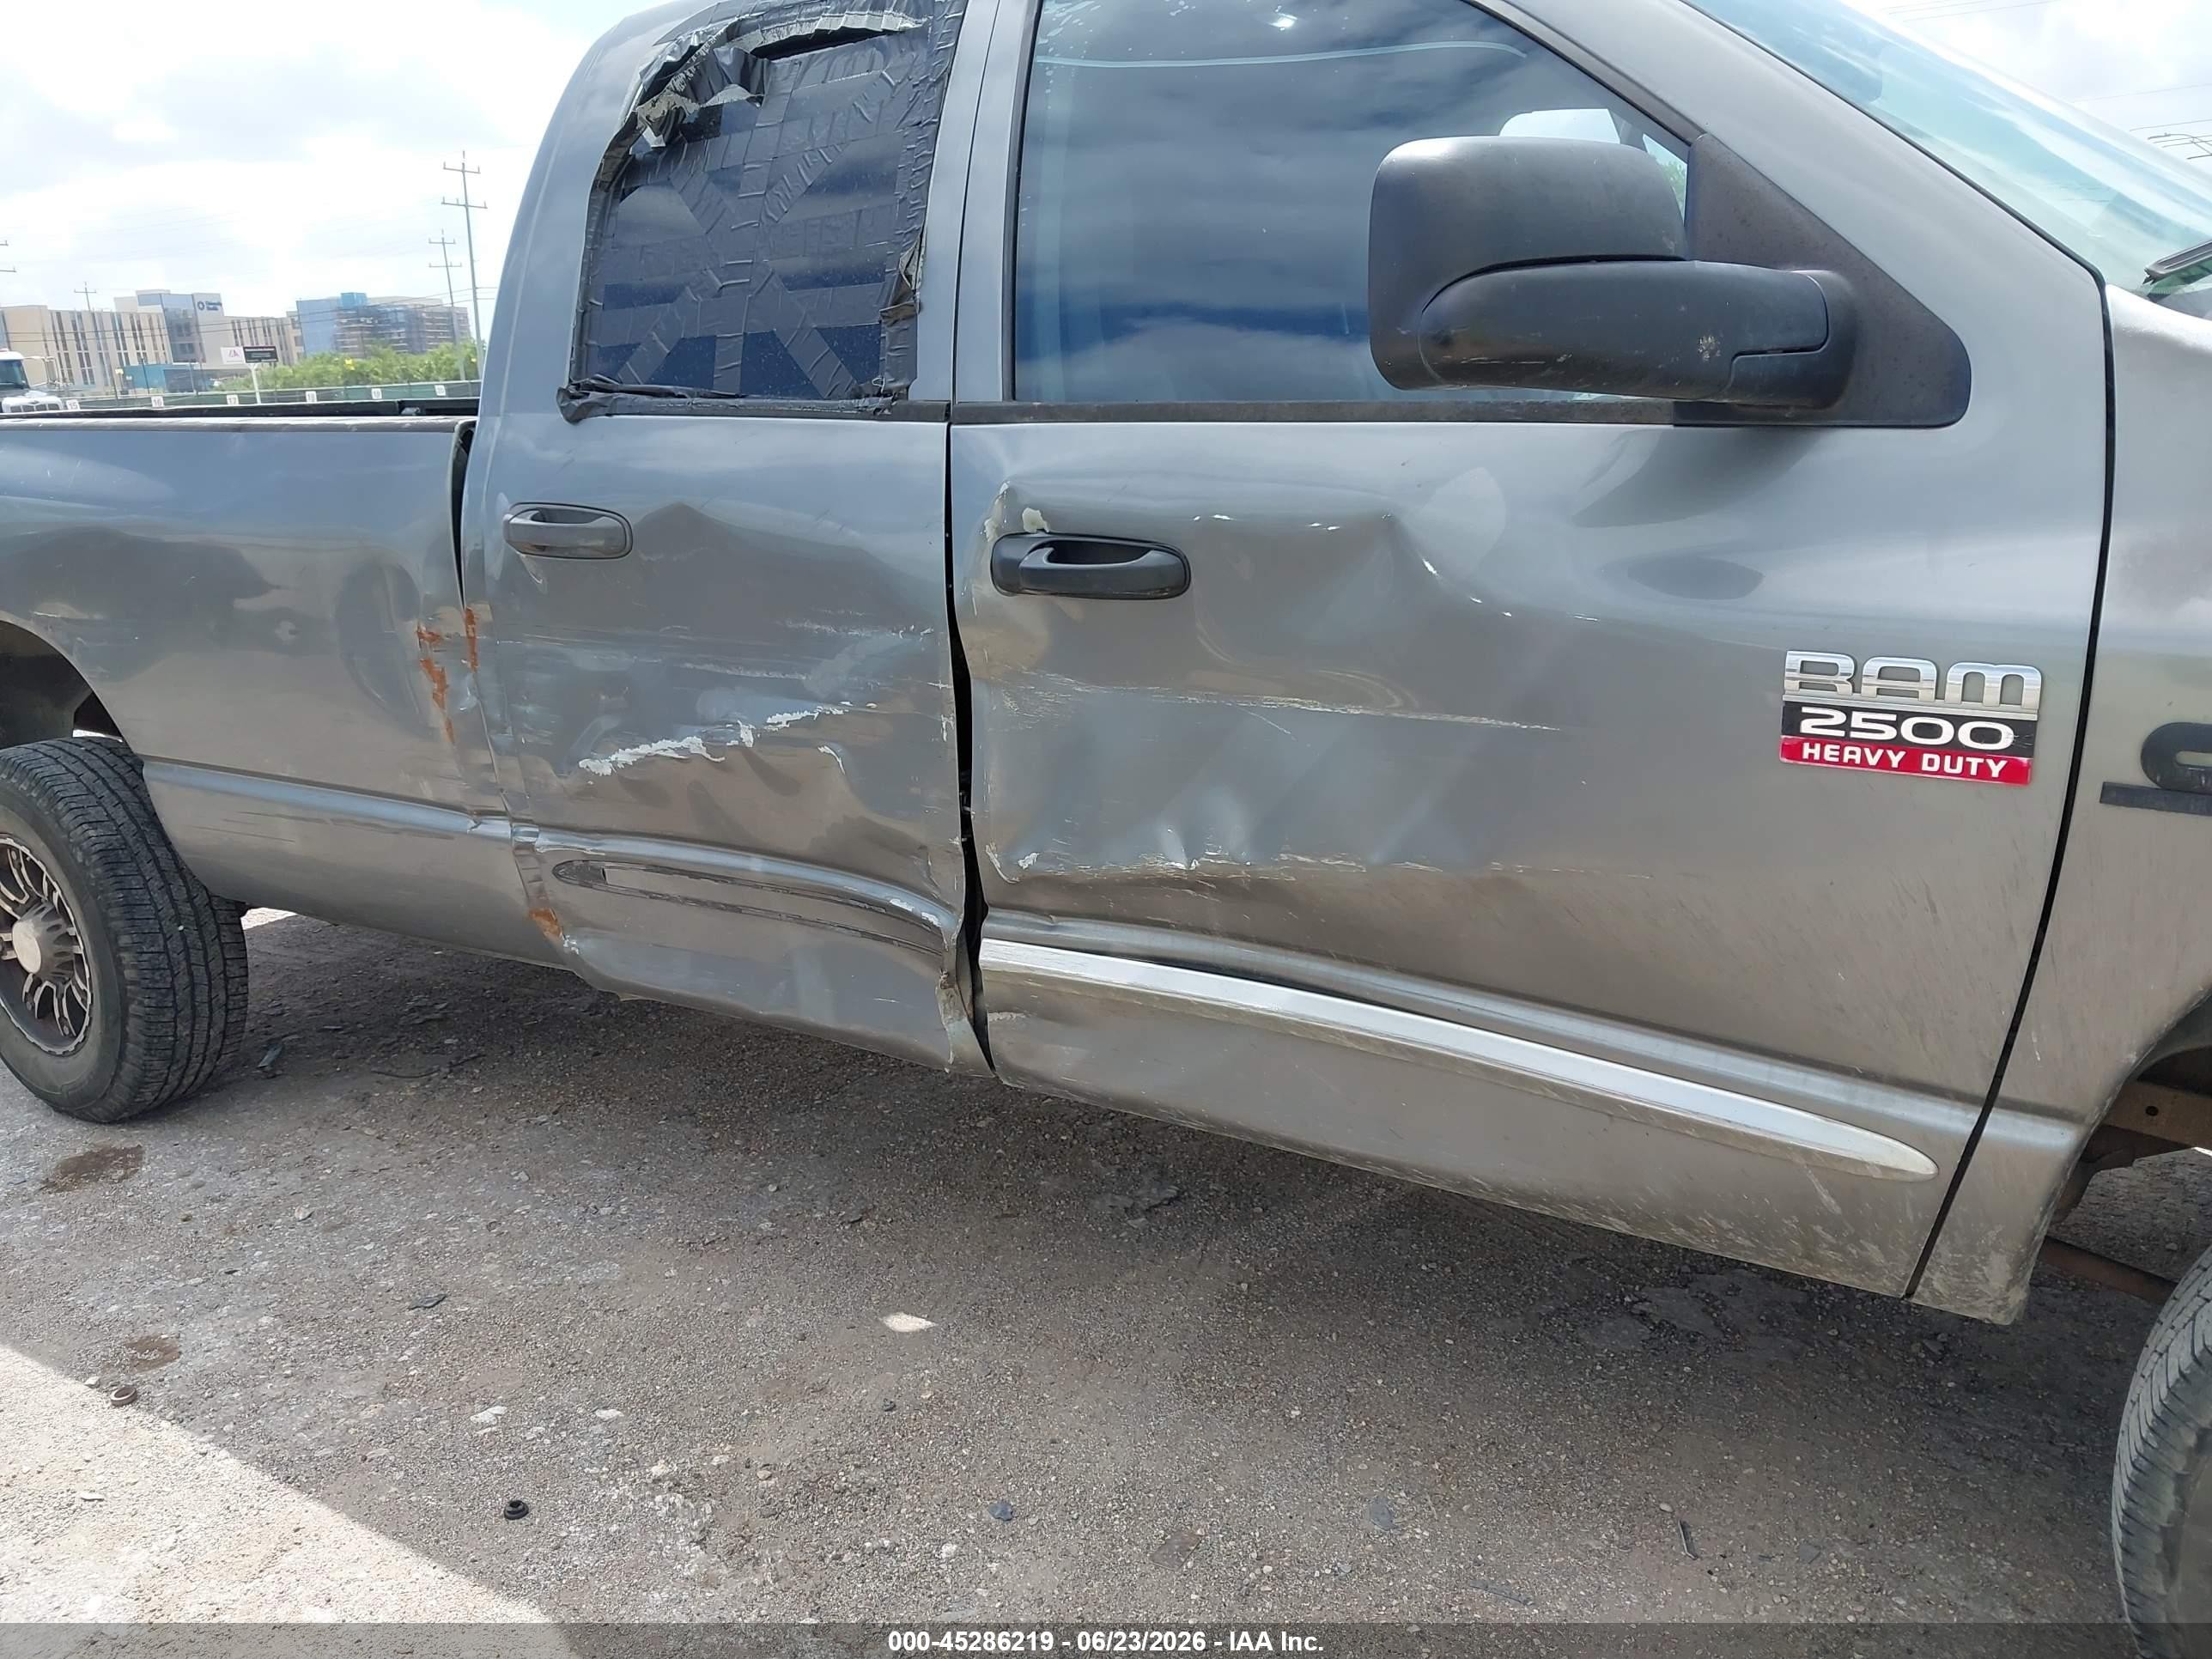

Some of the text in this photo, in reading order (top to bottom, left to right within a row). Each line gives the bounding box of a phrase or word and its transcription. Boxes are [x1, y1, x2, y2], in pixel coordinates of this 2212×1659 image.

[1784, 650, 2042, 709] RAM
[1800, 706, 2015, 750] 2500
[1802, 742, 2008, 778] HEAVY DUTY
